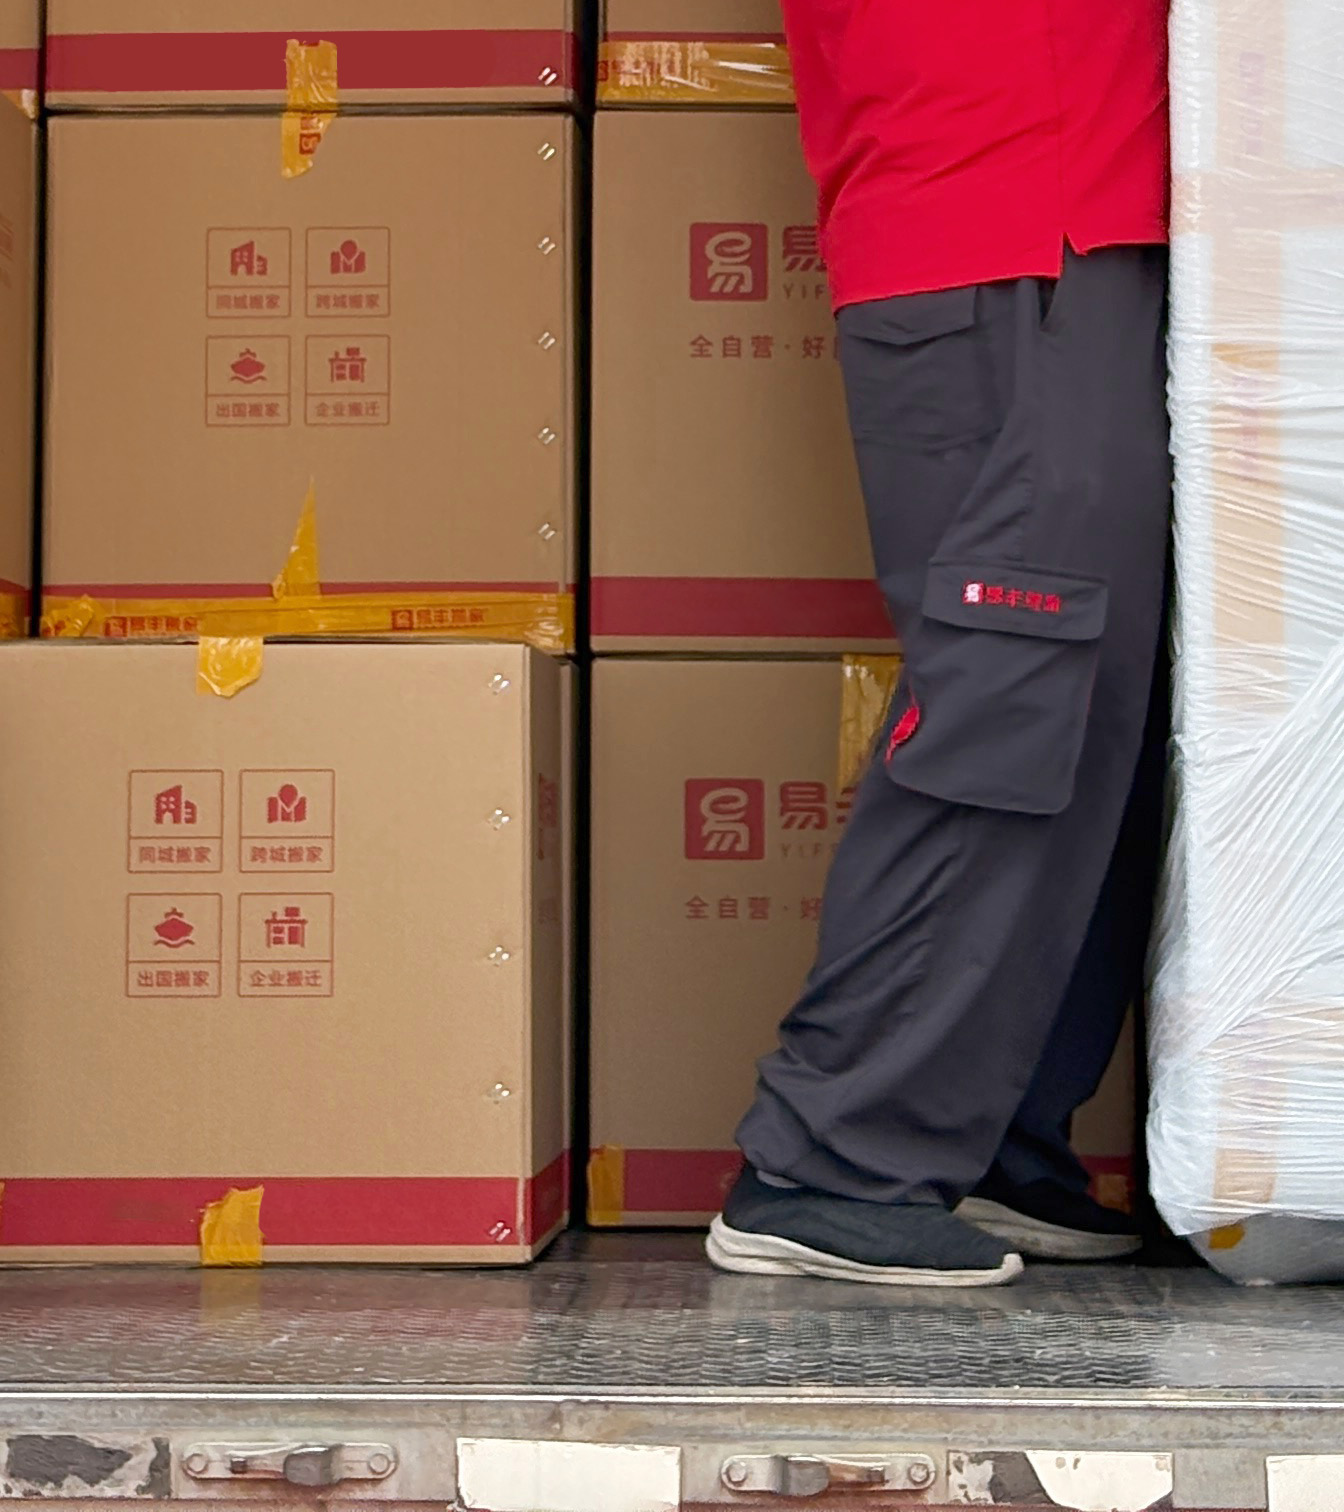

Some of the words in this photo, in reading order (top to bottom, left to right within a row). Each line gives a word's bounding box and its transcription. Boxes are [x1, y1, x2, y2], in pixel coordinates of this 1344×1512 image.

[689, 334, 840, 360] 全自营·好
[138, 845, 211, 864] 同城搬家
[137, 969, 210, 987] 出国搬家
[250, 969, 322, 987] 企业搬迁
